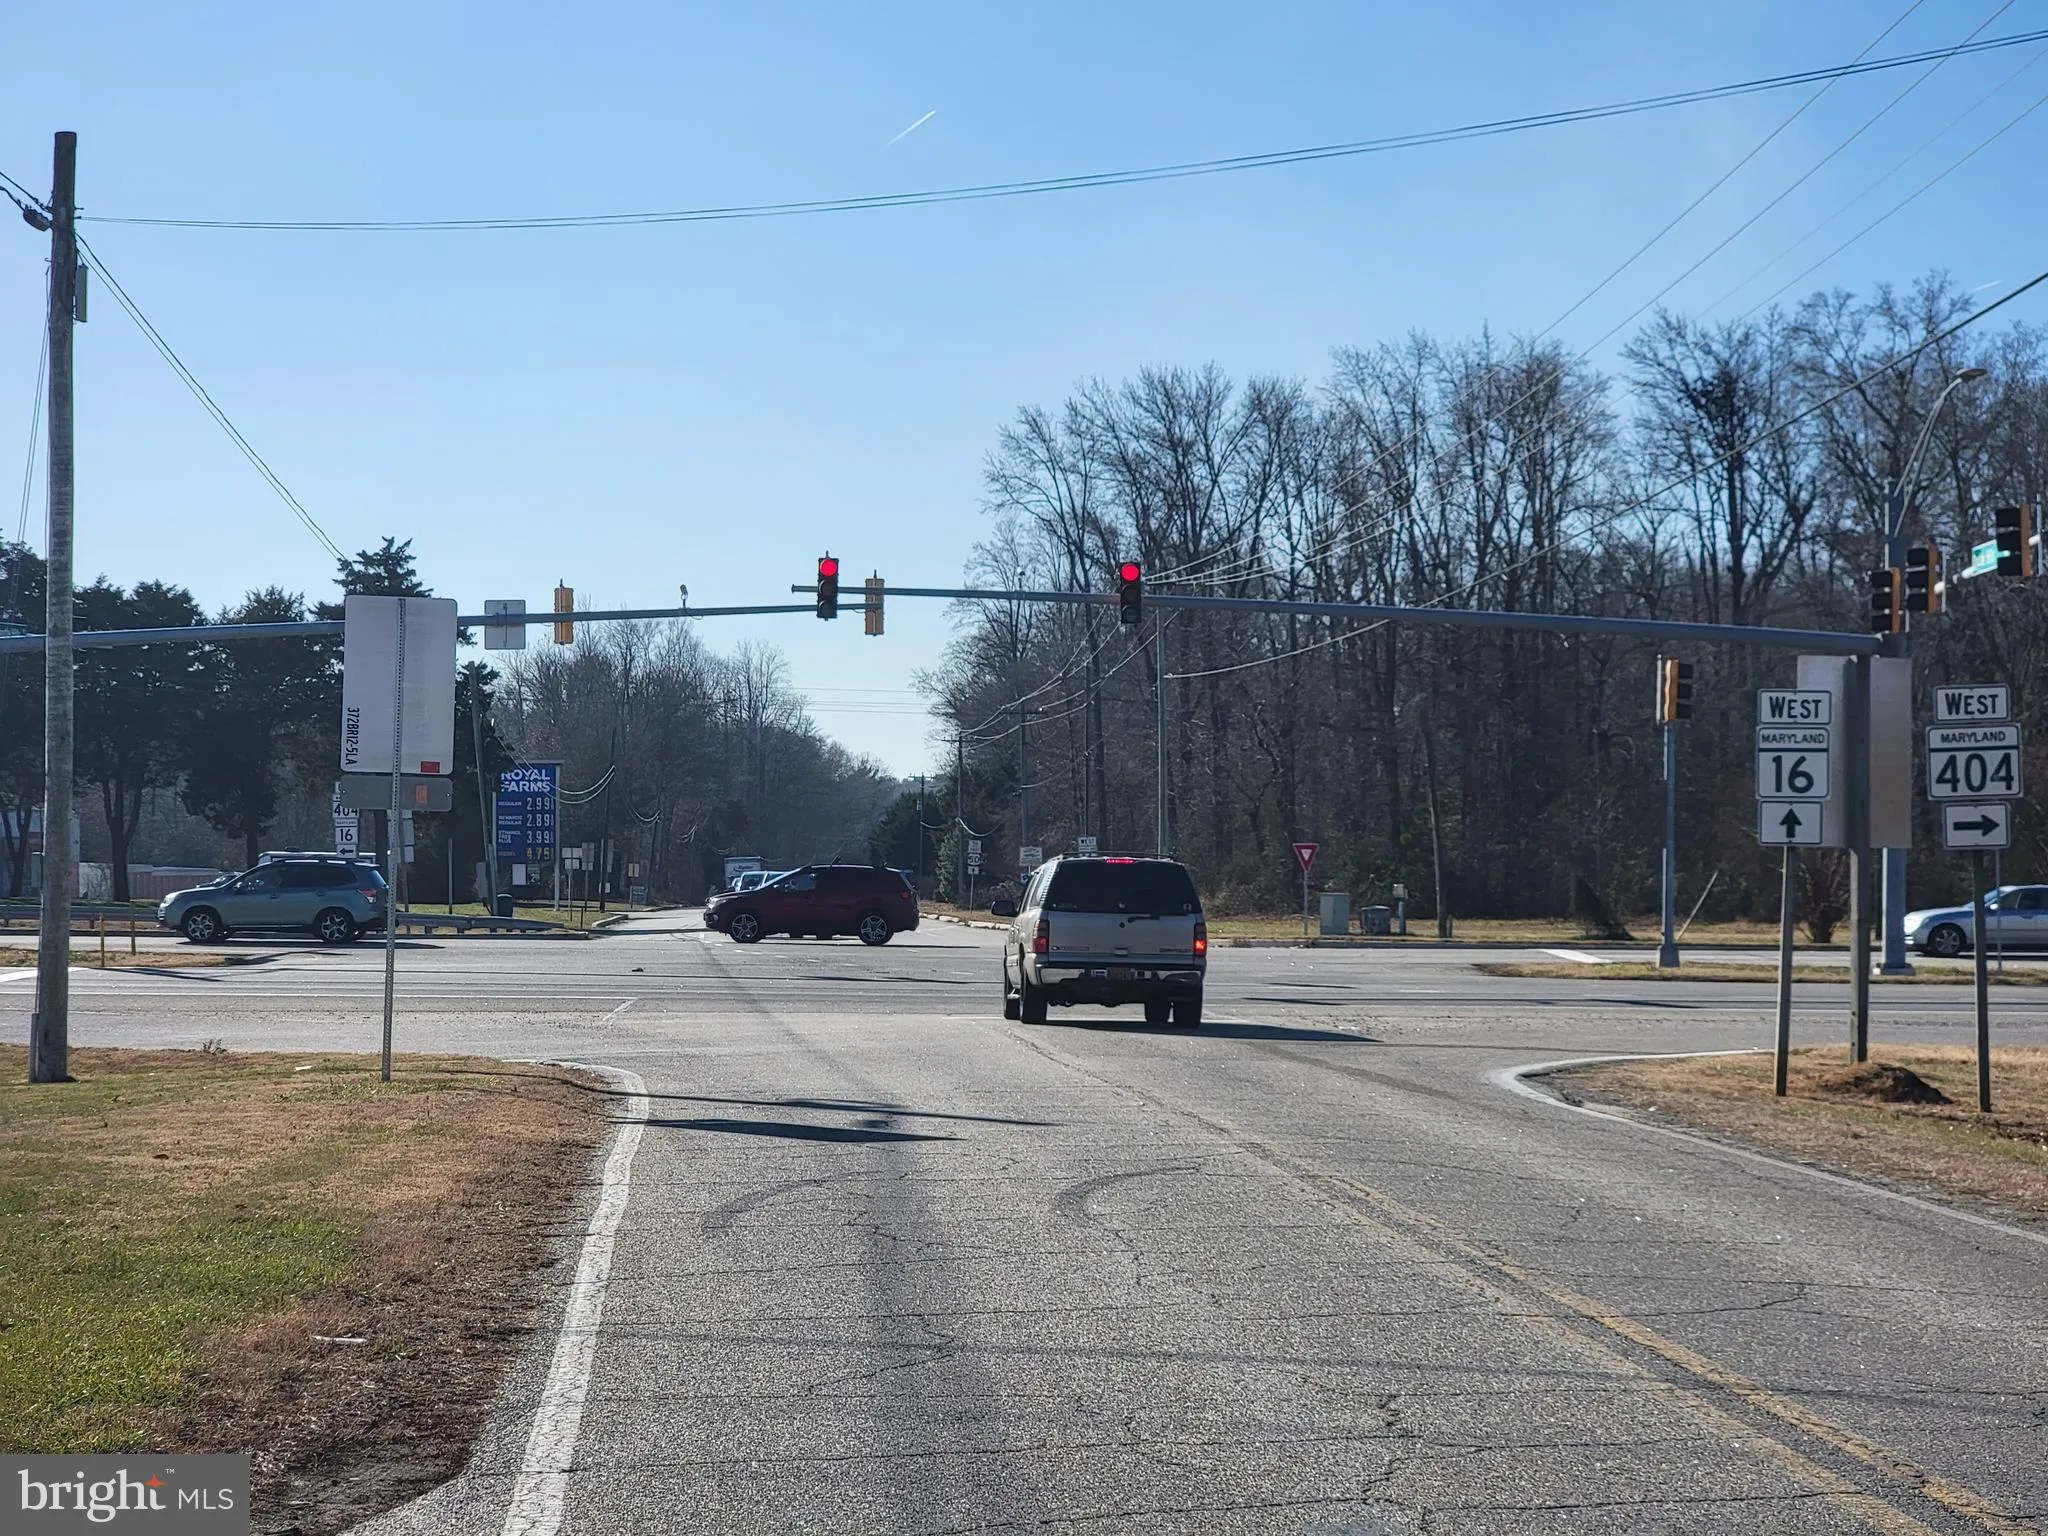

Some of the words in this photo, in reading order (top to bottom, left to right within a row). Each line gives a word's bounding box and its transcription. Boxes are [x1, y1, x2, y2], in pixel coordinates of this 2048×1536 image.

[1768, 695, 1822, 719] WEST
[1945, 692, 1999, 716] WEST
[1761, 732, 1825, 745] MARYLAND
[1941, 730, 2006, 744] MARYLAND
[1771, 755, 1814, 794] 16
[1935, 752, 2014, 793] 404
[501, 781, 550, 792] FARMS
[340, 828, 354, 842] 16
[968, 855, 980, 864] 50
